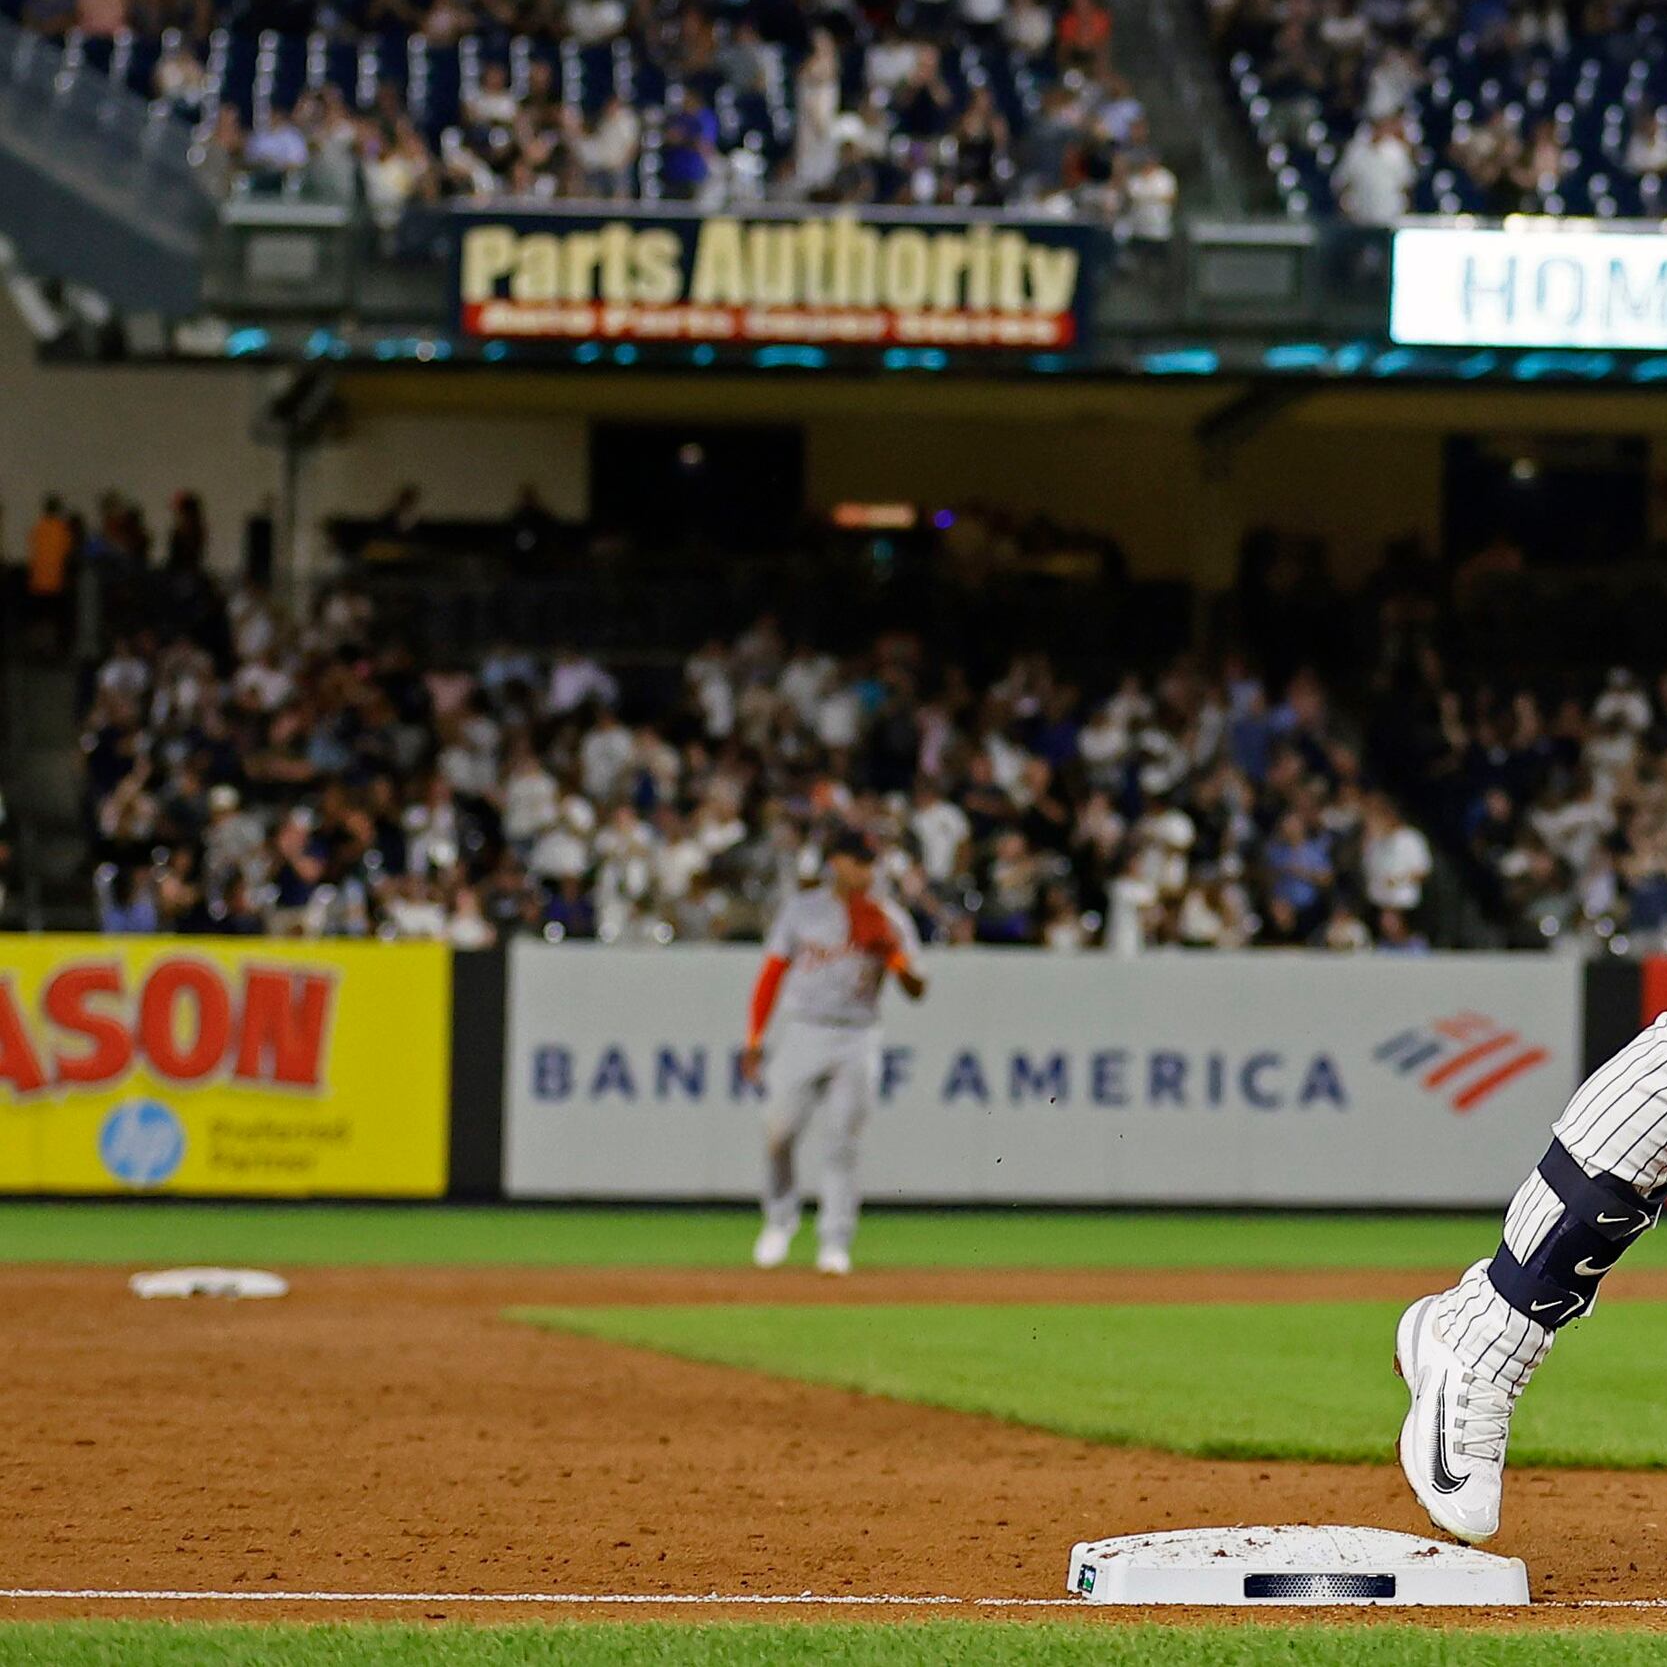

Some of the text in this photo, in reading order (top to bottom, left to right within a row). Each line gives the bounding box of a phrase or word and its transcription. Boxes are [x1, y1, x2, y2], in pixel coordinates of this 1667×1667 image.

[461, 212, 1080, 313] Parts Authority
[941, 1046, 1348, 1112] AMERICA
